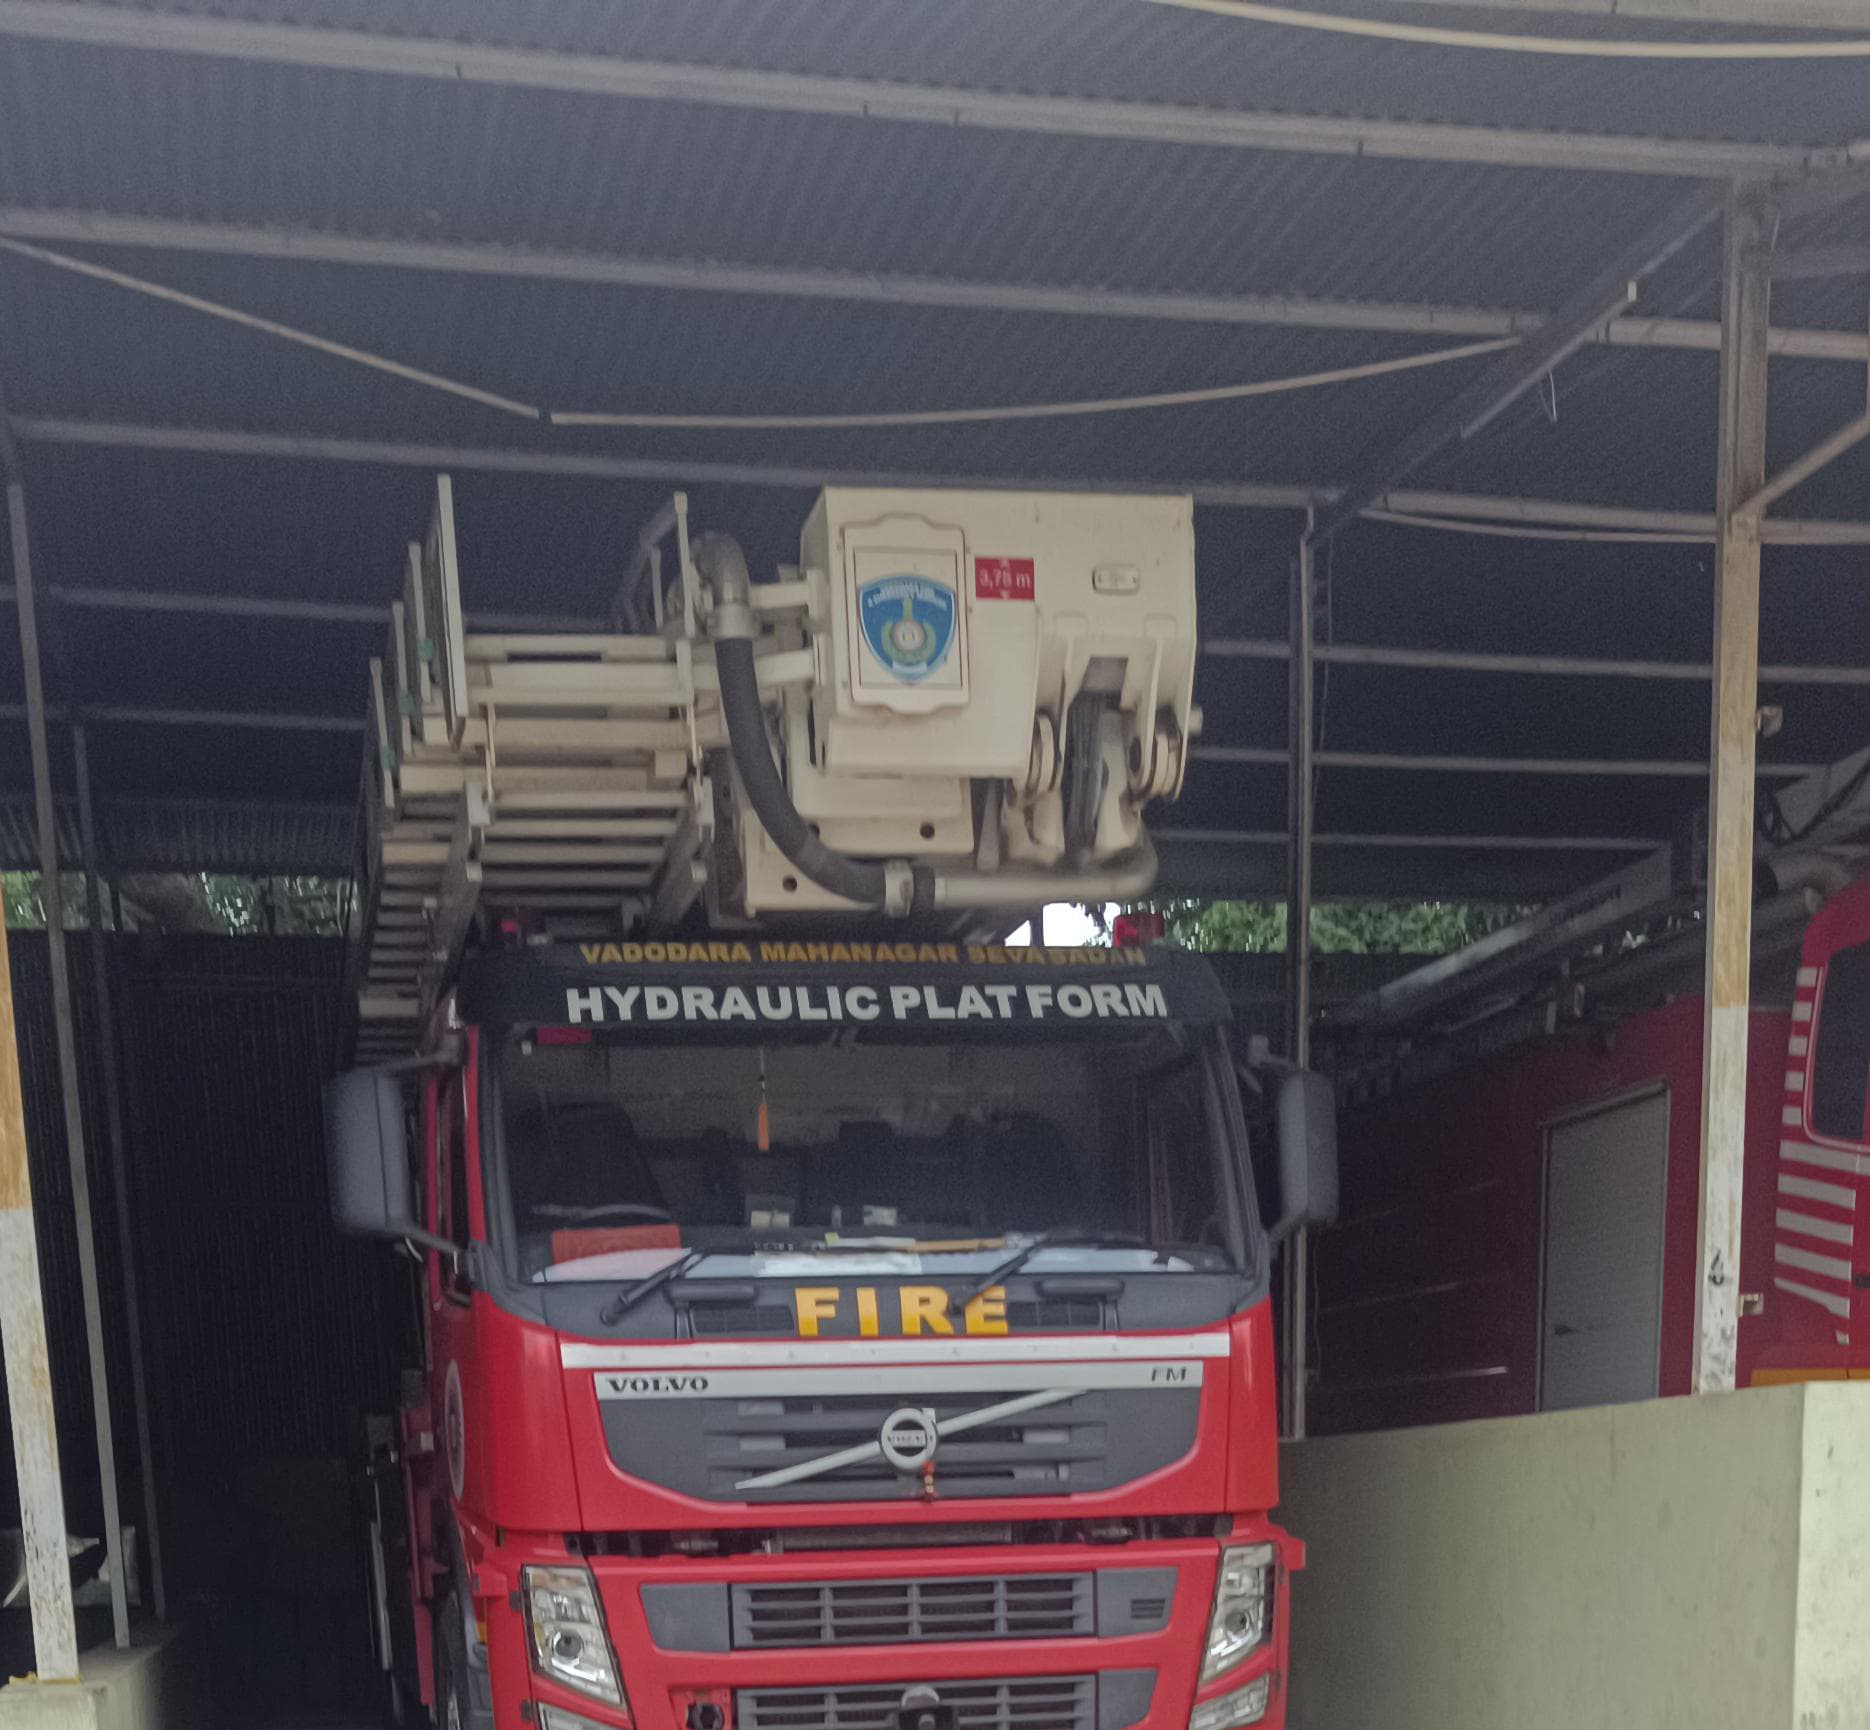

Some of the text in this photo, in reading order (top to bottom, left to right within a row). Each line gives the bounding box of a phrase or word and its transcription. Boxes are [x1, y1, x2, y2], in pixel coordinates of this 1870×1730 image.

[1016, 572, 1031, 589] m
[580, 942, 751, 964] VADODARA
[760, 942, 958, 962] MAHANAGAR
[566, 985, 880, 1023] HYDRAULIC
[795, 1286, 1009, 1336] FIRE
[1151, 1367, 1187, 1382] FM
[607, 1377, 709, 1392] VOLVO
